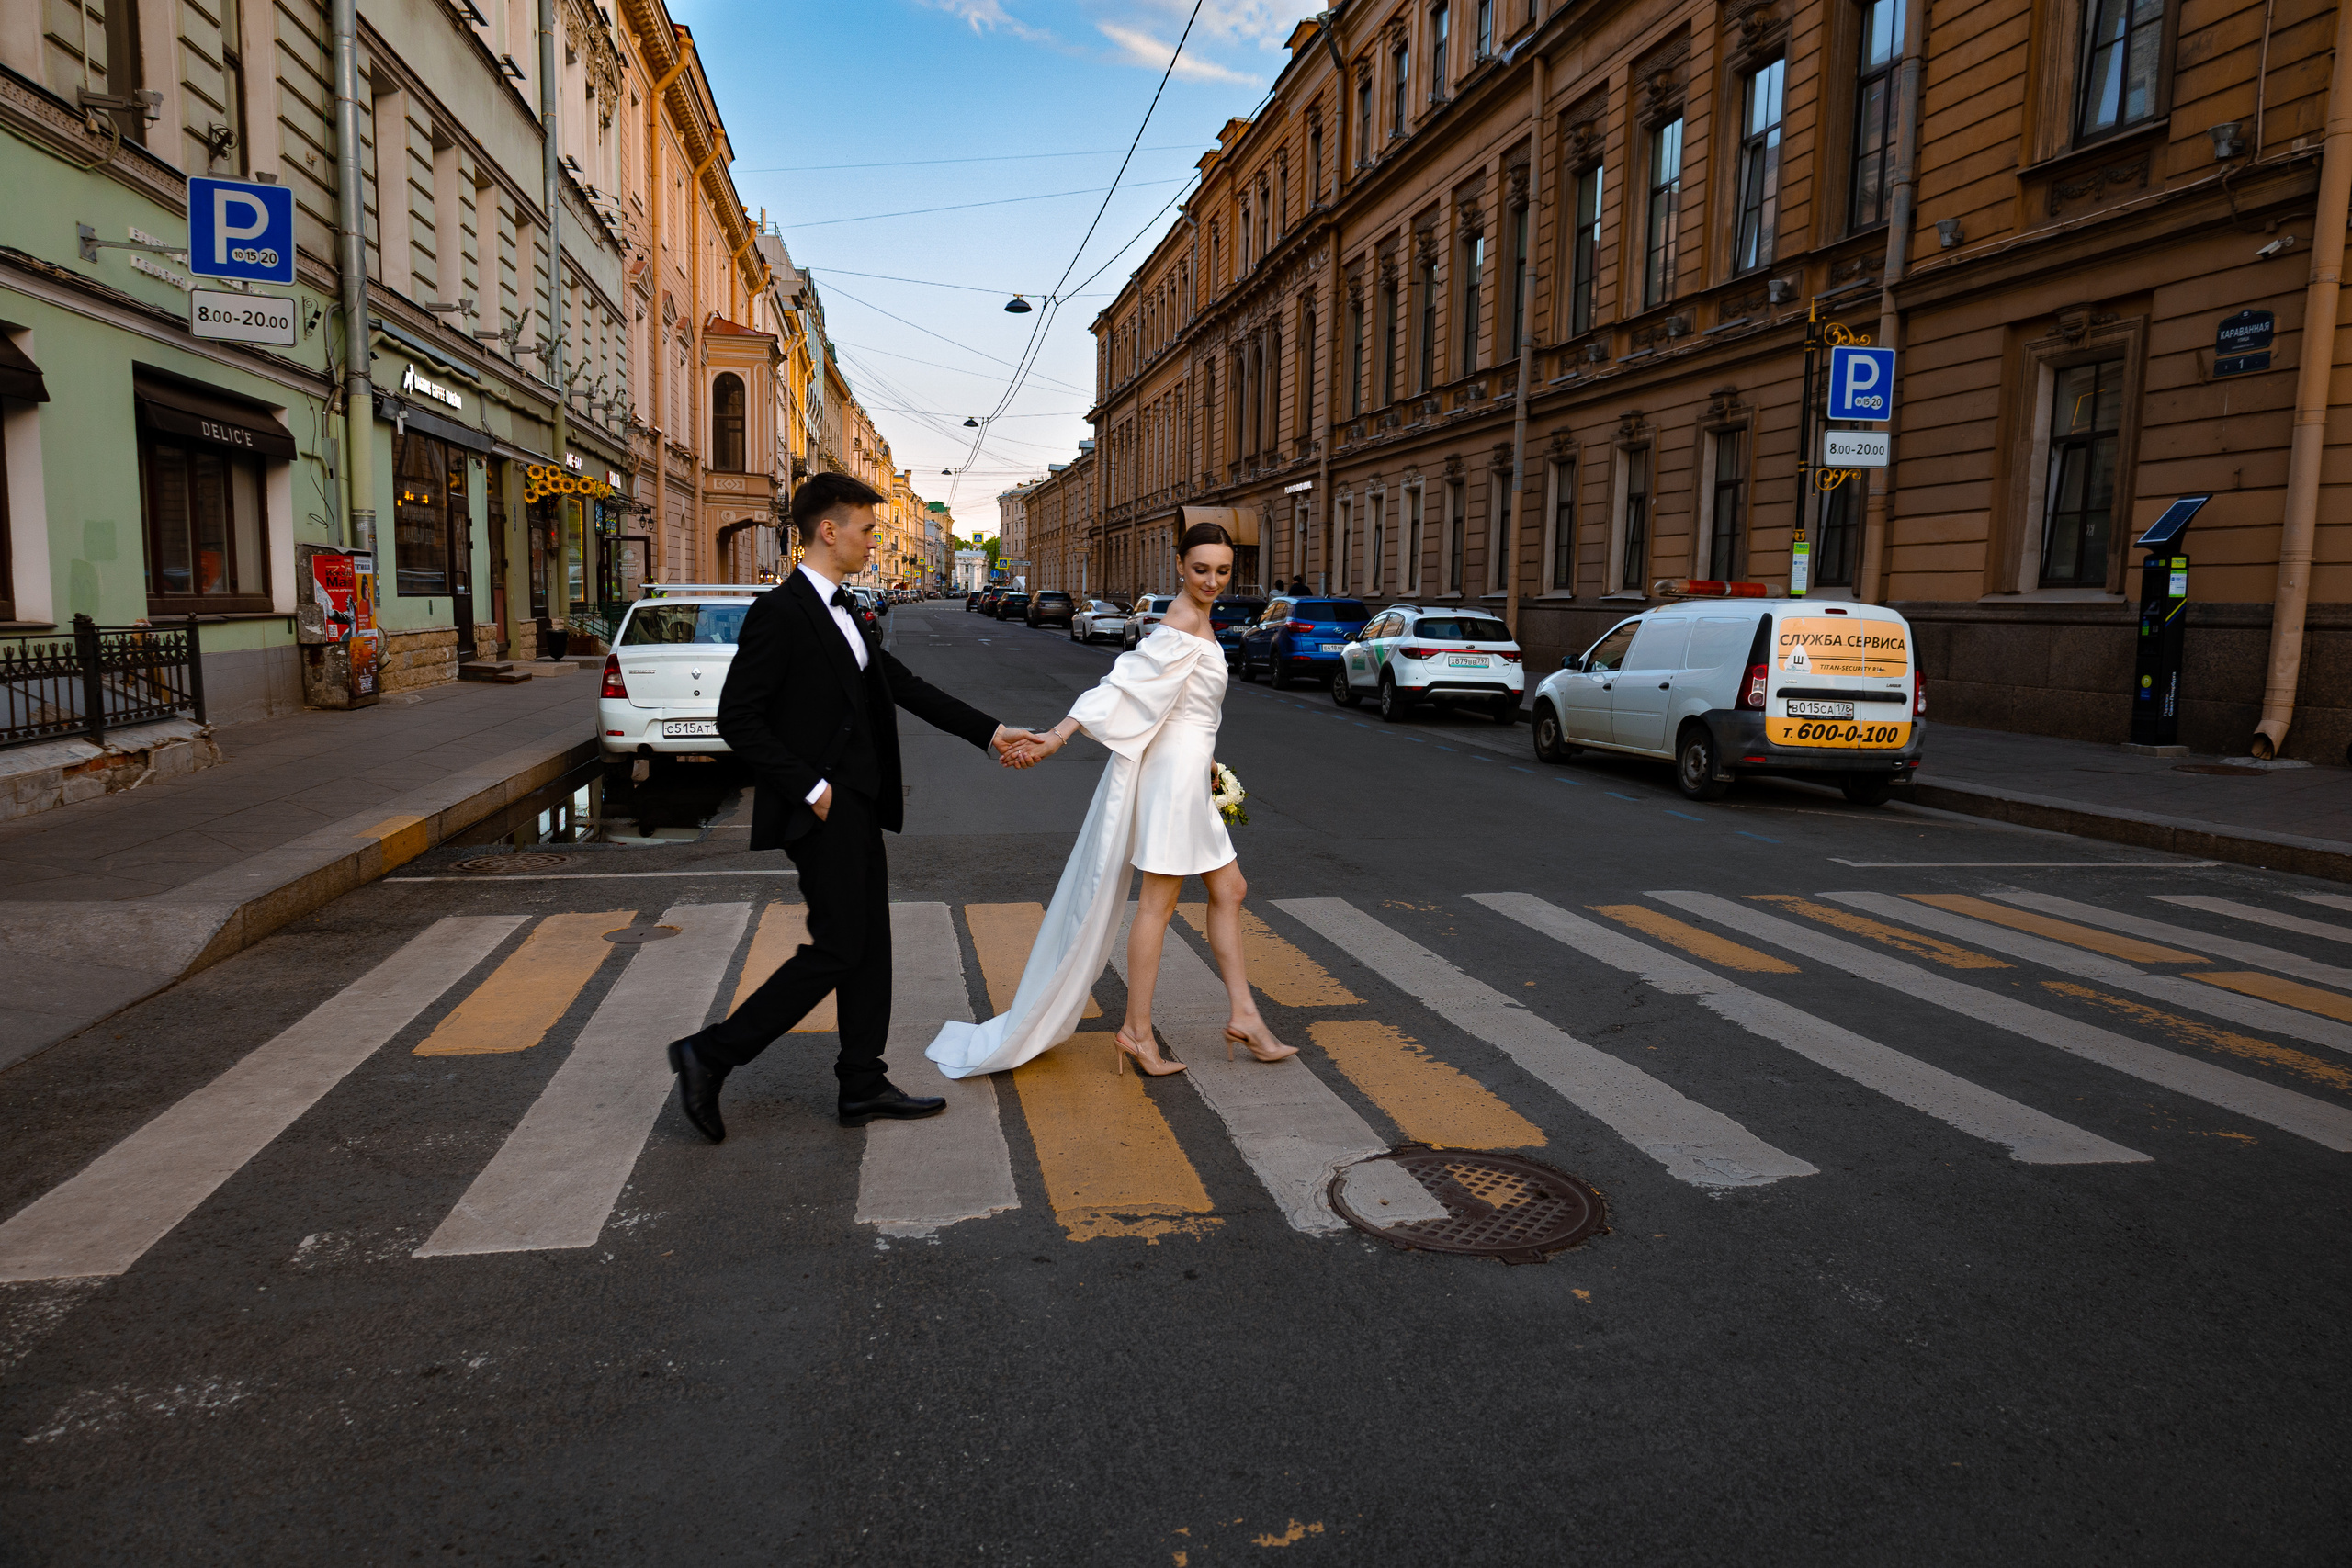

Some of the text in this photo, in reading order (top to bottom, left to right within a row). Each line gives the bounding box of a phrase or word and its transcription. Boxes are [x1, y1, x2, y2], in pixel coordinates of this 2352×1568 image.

[214, 188, 269, 264] P
[234, 251, 277, 264] 10 15 20
[2220, 321, 2270, 340] КАРАВАННАЯ
[2239, 358, 2245, 369] 1
[432, 382, 447, 402] COFFEE
[1844, 355, 1880, 410] P
[1871, 398, 1882, 406] 20
[201, 421, 254, 446] DELIC'E
[1780, 634, 1905, 650] СЛУЖБА СЕРВИСА
[1836, 704, 1849, 713] 178
[1797, 723, 1898, 743] 600-0-100
